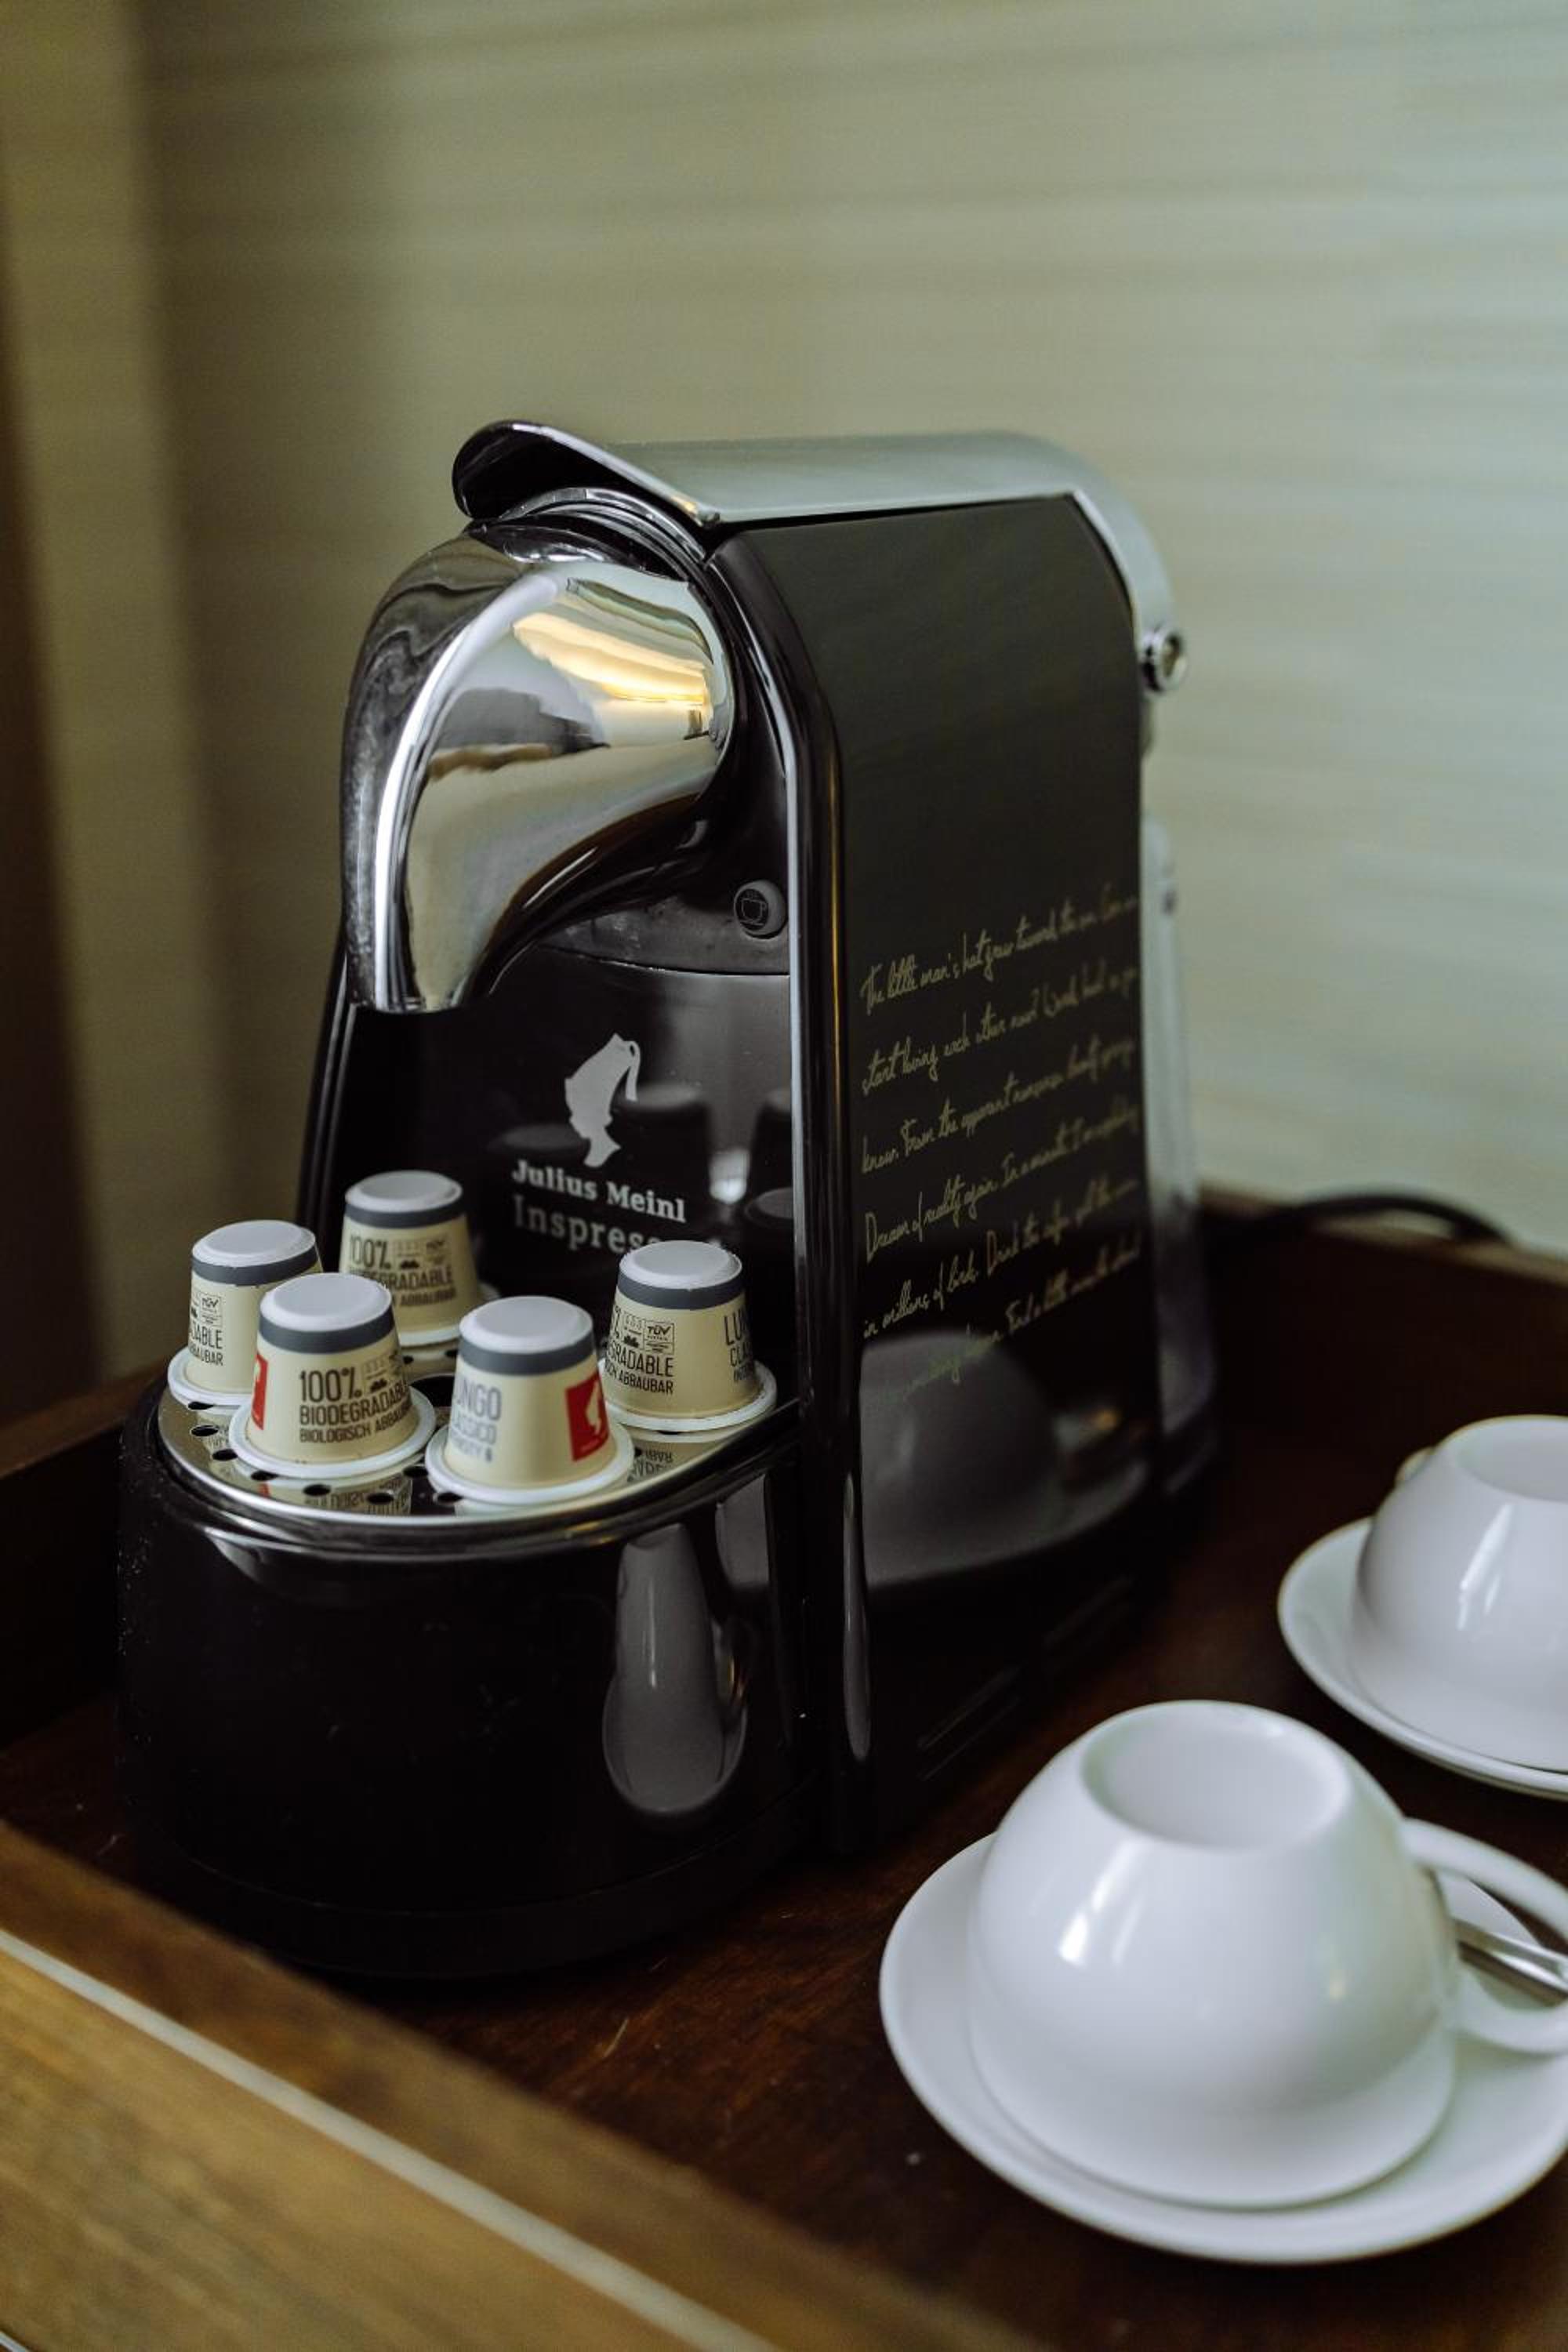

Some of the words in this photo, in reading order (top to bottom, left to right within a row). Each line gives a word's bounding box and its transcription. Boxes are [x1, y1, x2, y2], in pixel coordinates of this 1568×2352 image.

[860, 964, 885, 1014] The
[512, 1160, 597, 1201] Julius
[606, 1181, 686, 1224] Meinl
[647, 1324, 671, 1336] TÜV
[299, 1367, 362, 1403] 100%
[619, 1369, 673, 1395] ABBAUBAR
[299, 1421, 371, 1443] BIOLOGISCH
